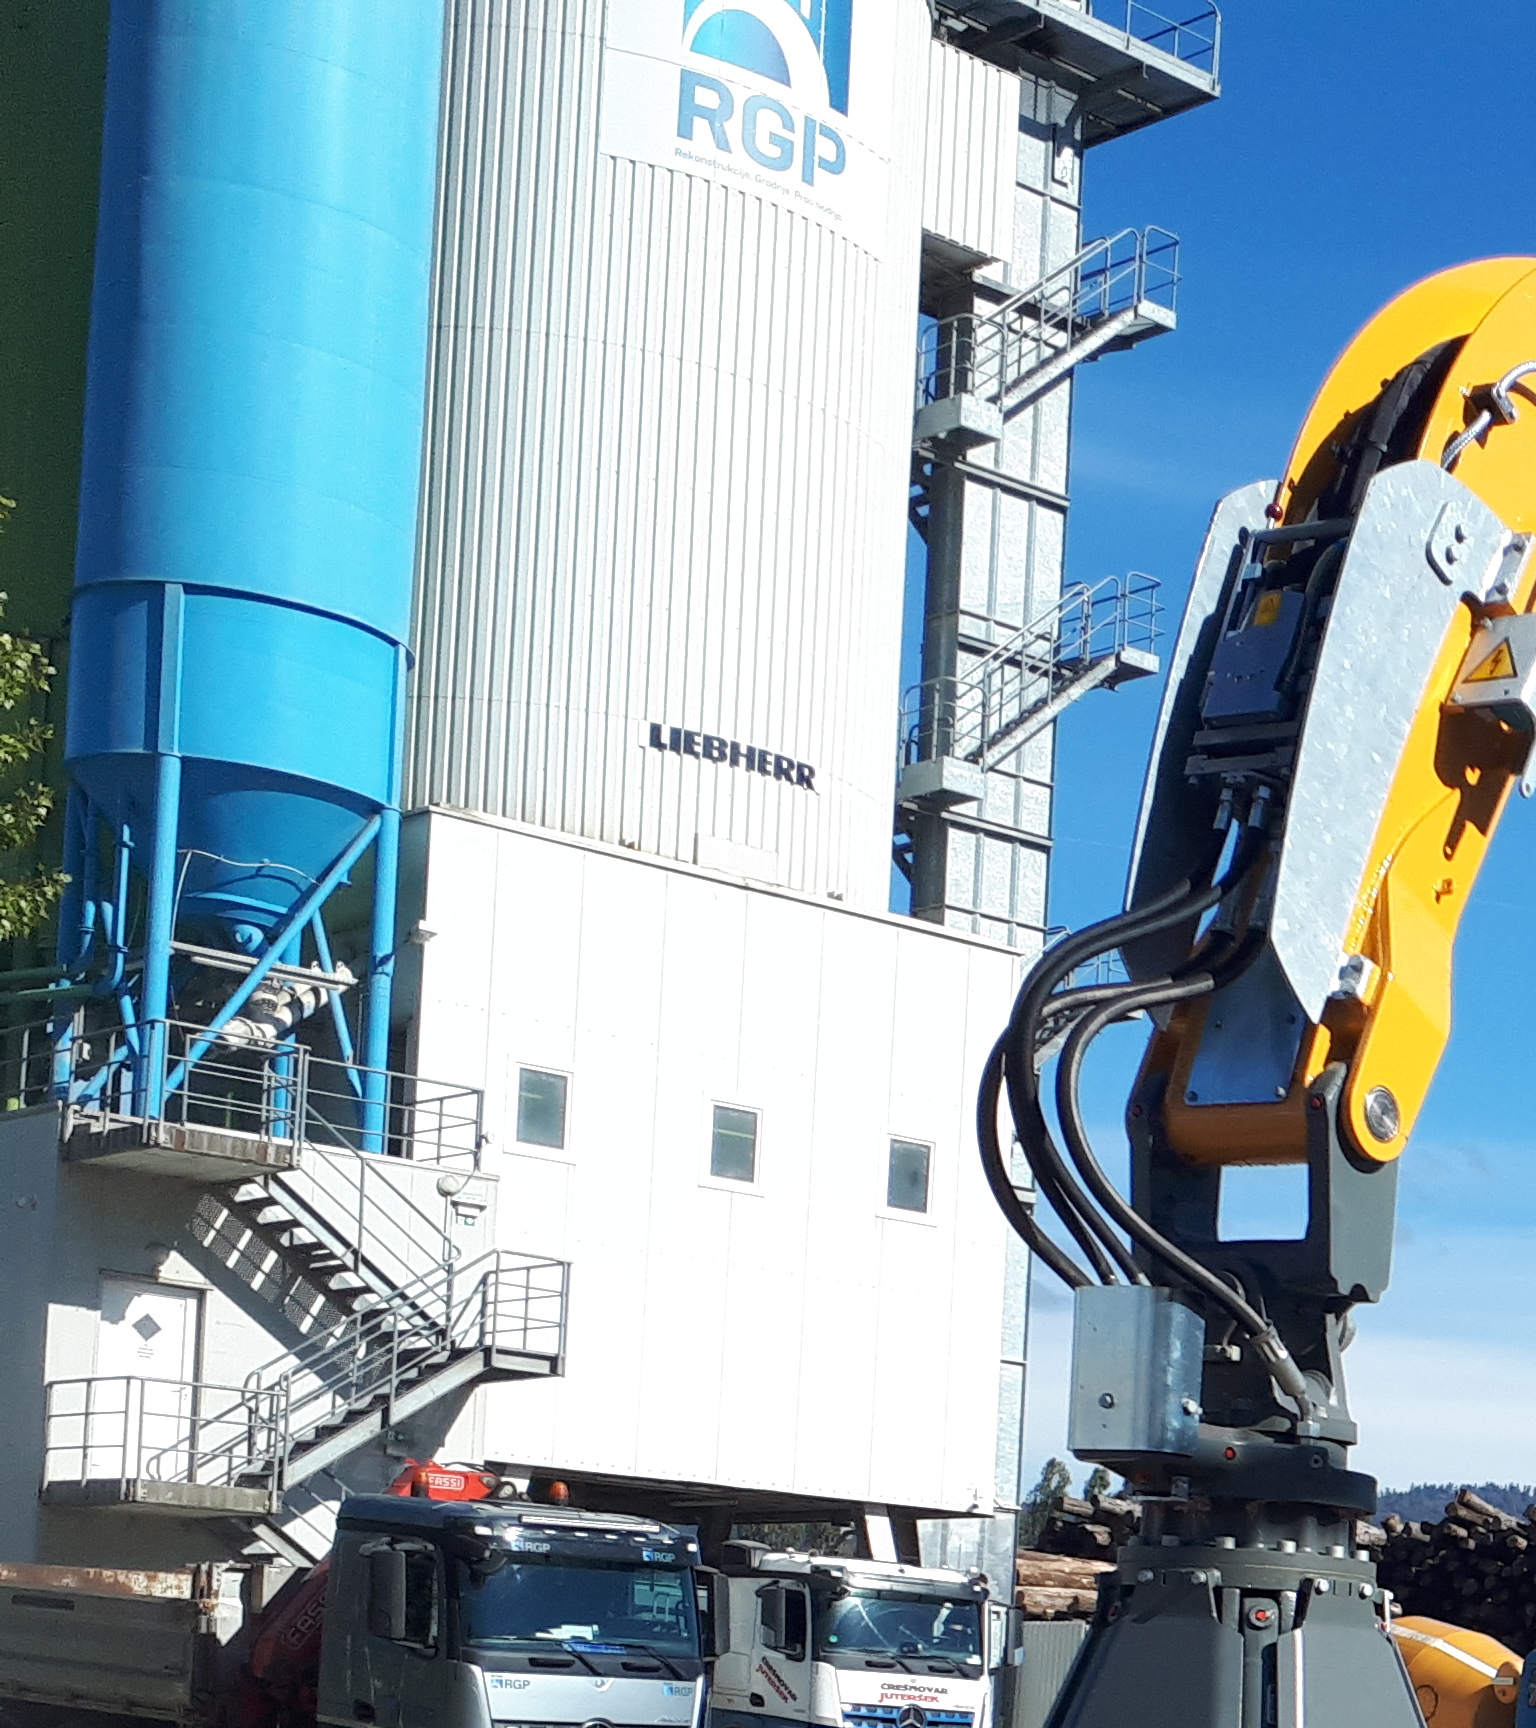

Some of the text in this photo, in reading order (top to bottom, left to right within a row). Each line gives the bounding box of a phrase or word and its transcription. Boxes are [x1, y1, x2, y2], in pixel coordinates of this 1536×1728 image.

[677, 68, 847, 188] RGP
[649, 722, 818, 794] LIEBHERR
[525, 1541, 551, 1553] RGP
[655, 1551, 676, 1562] RGP
[504, 1679, 531, 1690] RGP
